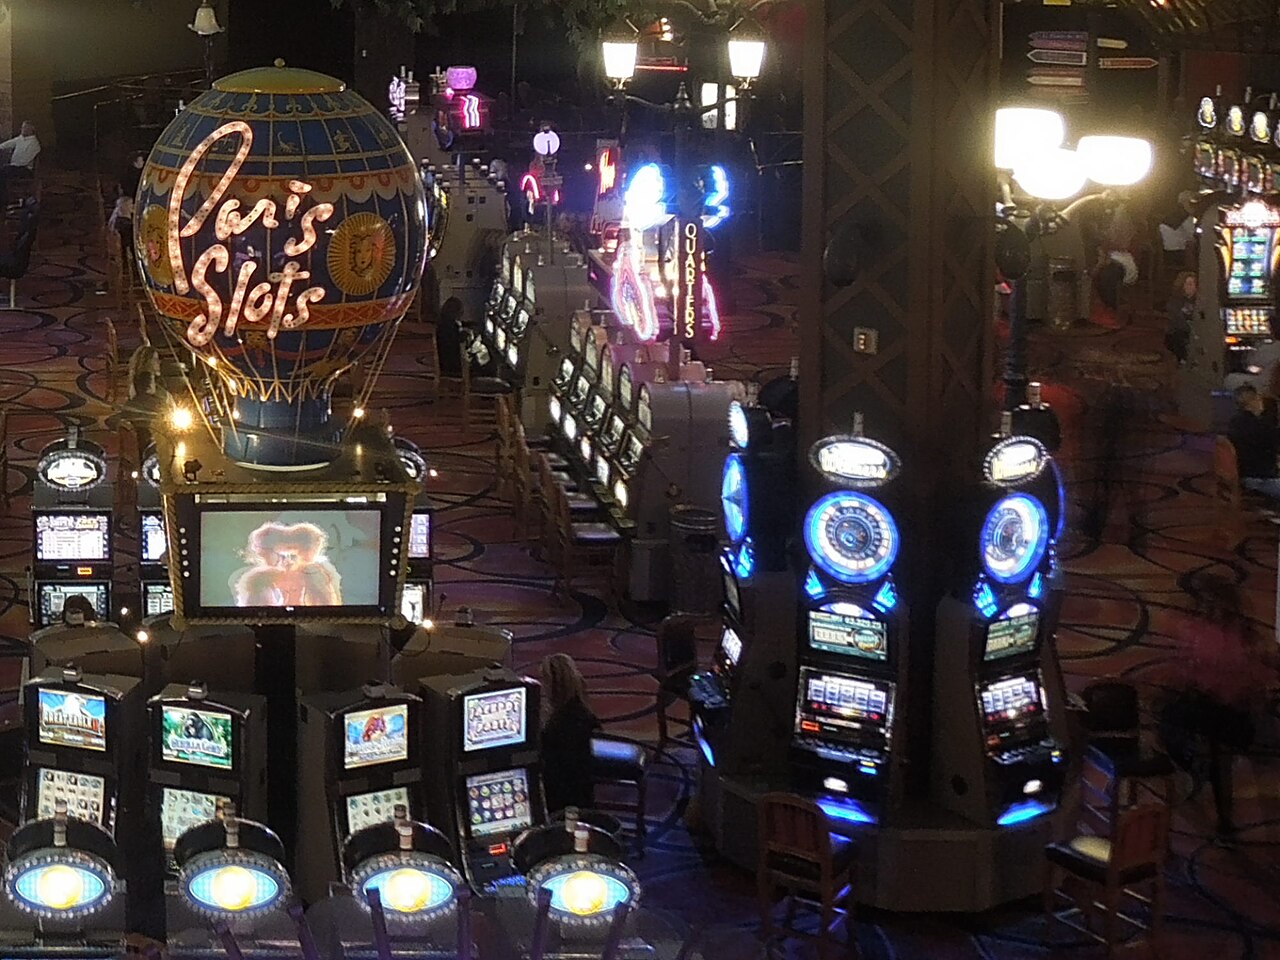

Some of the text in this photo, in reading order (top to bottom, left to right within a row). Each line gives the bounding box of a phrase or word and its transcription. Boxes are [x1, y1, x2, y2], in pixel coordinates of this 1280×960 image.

[168, 121, 334, 295] Paris
[187, 244, 326, 347] Slots
[685, 223, 697, 338] QUARTERS
[469, 700, 519, 721] JACKPOT
